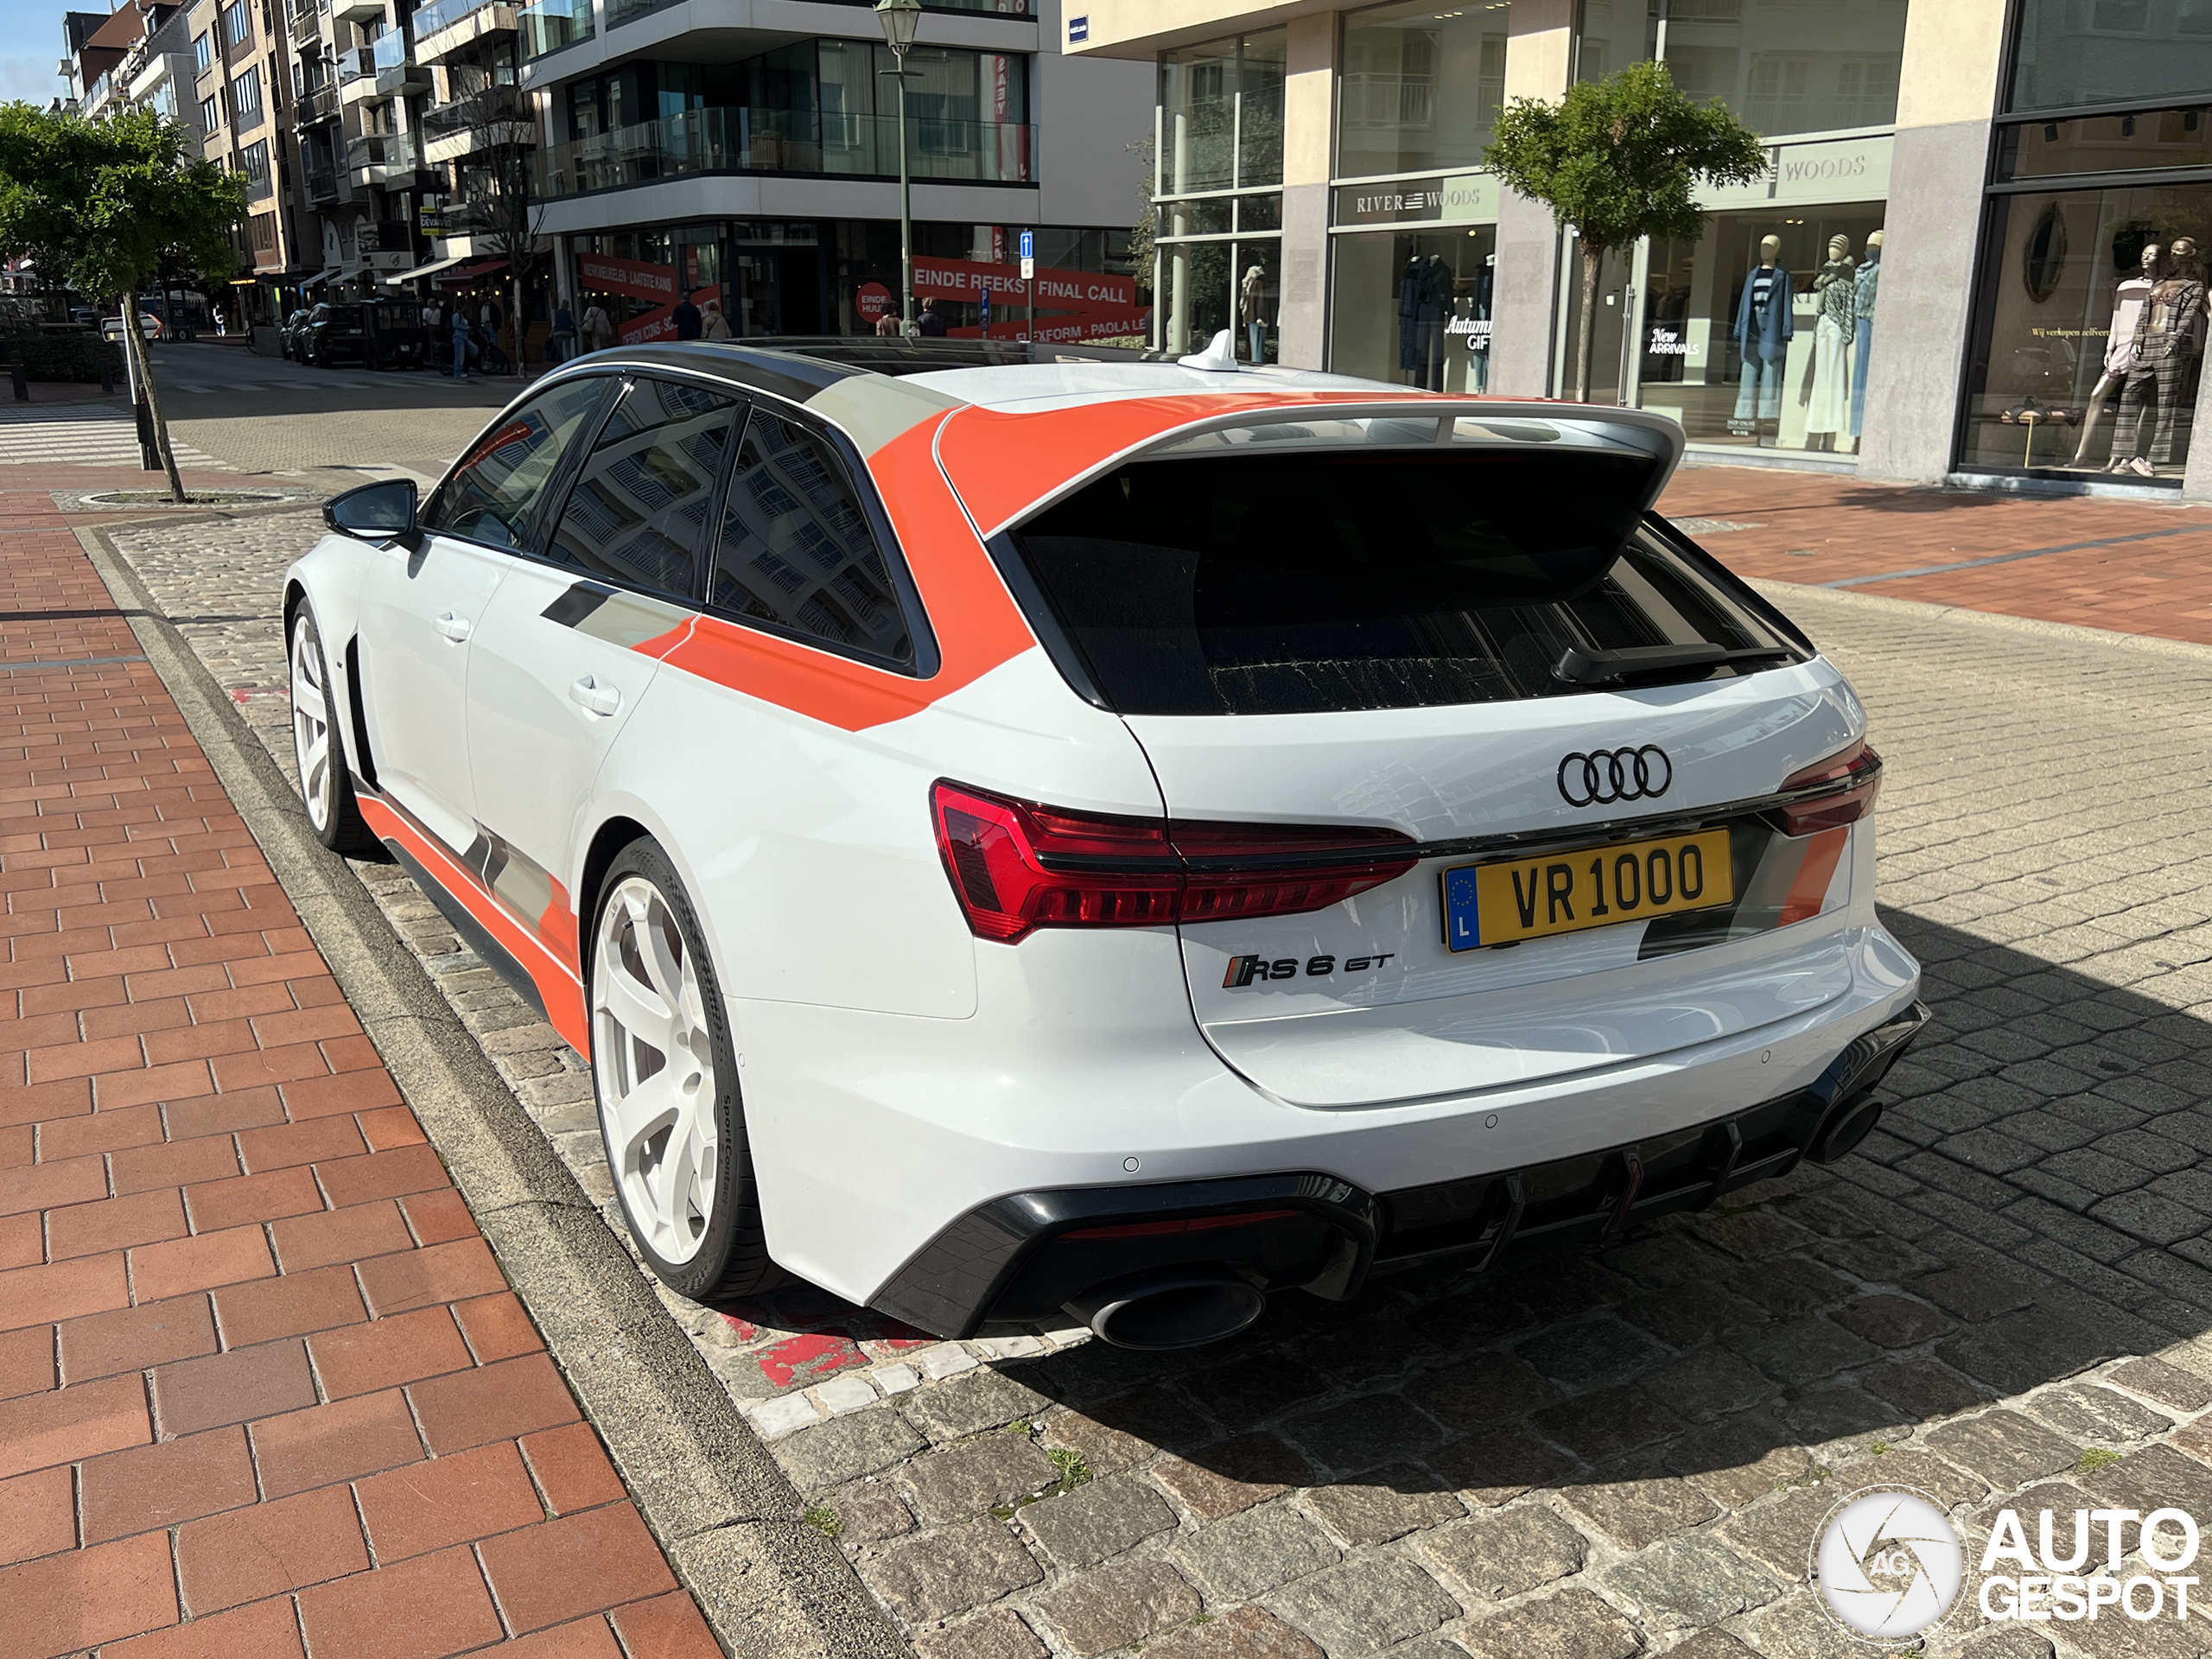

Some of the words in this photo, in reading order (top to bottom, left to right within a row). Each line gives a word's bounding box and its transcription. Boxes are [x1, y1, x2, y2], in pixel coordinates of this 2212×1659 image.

[1785, 156, 1866, 181] WOODS
[1357, 194, 1403, 213] RIVER
[1426, 188, 1480, 207] WOODS
[629, 270, 654, 289] LAATSTE
[655, 276, 672, 293] KANS
[914, 269, 966, 289] EINDE
[970, 274, 1026, 295] REEKS
[1039, 281, 1084, 299] FINAL
[1088, 286, 1128, 303] CALL
[861, 304, 882, 313] HUU
[1090, 320, 1129, 335] PAOLA
[1132, 318, 1147, 330] LE
[1651, 327, 1678, 343] New
[2031, 327, 2045, 338] Wij
[2046, 327, 2080, 339] verkopen
[1467, 334, 1492, 350] GIF
[1649, 342, 1700, 355] ARRIVALS
[1512, 864, 1575, 928] VR
[1589, 845, 1703, 917] 1000
[1459, 917, 1470, 937] L
[1241, 956, 1299, 983] RS
[1306, 955, 1336, 976] 6
[1344, 953, 1395, 972] GT
[721, 1095, 733, 1206] SportContact
